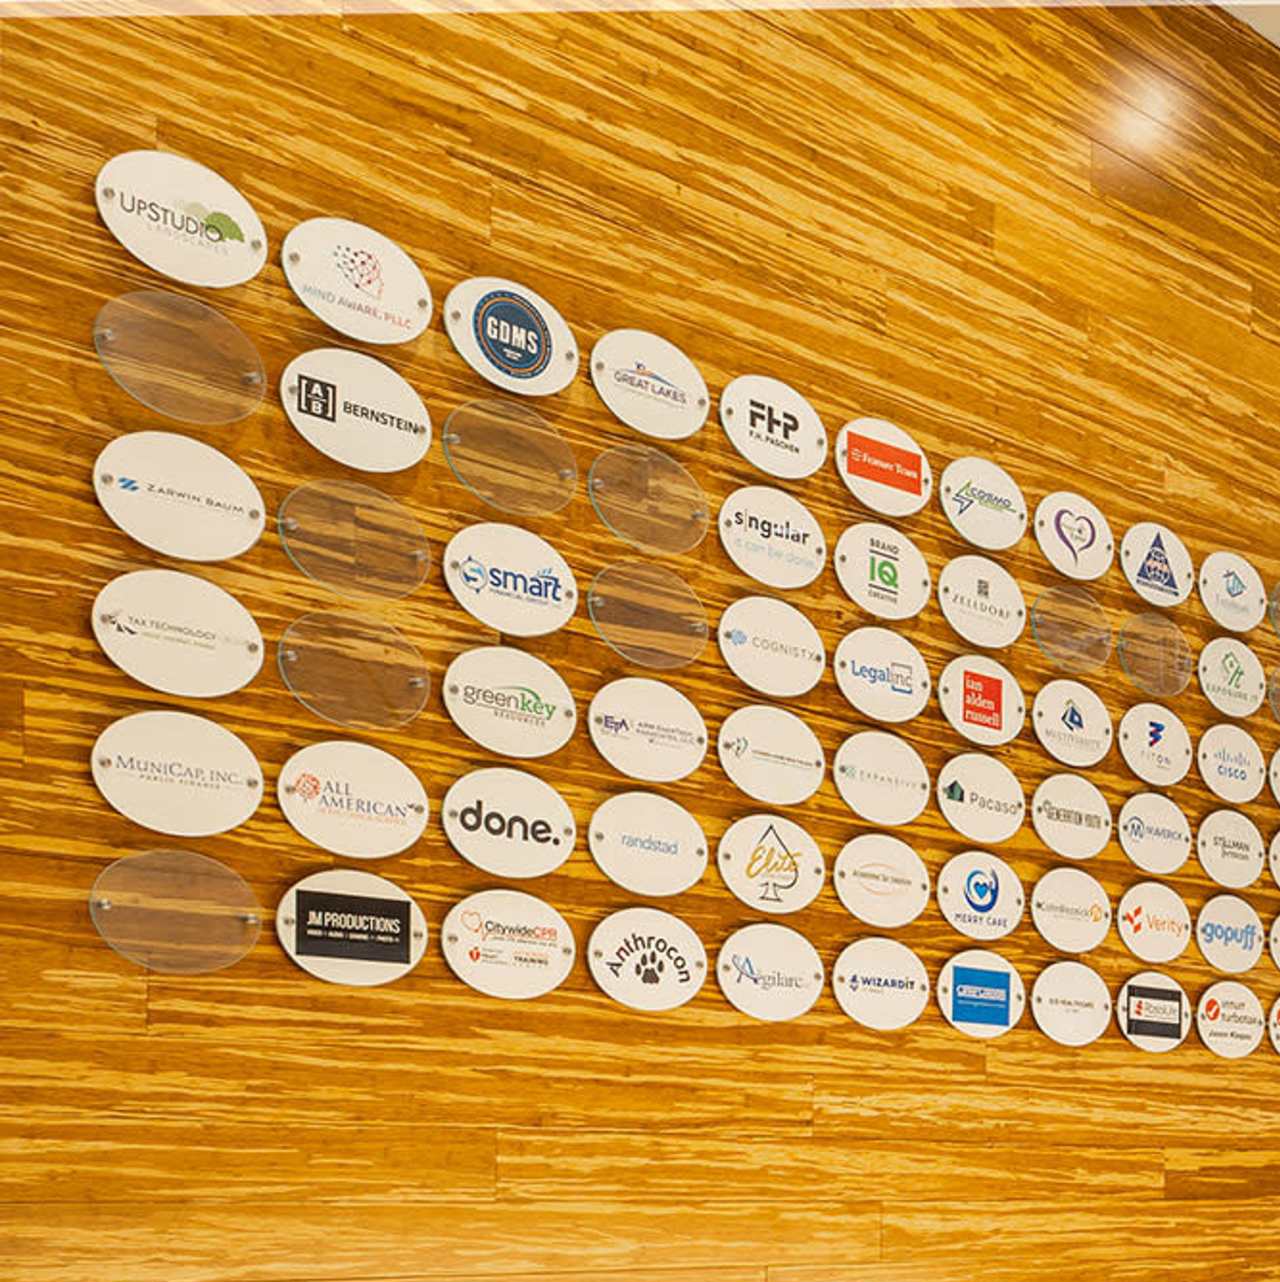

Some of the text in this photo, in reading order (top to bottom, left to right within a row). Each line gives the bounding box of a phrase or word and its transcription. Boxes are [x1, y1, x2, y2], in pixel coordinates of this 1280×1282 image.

[301, 285, 335, 304] MIND
[486, 316, 538, 354] GDMS
[614, 371, 651, 392] GREAT
[651, 382, 687, 404] LAKES
[342, 399, 419, 435] BERNSTEIN
[205, 494, 244, 514] BAUM
[870, 538, 899, 555] BRAND
[489, 567, 562, 602] smart
[868, 556, 899, 588] IQ
[127, 614, 147, 628] TAX
[149, 619, 217, 641] TECHNOLOGY
[463, 684, 557, 720] greenkey
[324, 779, 351, 797] ALL
[320, 792, 408, 819] AMERICAN
[969, 791, 1018, 816] Pacaso
[459, 800, 561, 846] done.
[621, 831, 678, 855] randstad
[306, 909, 402, 935] JM PRODUCTIONS
[1145, 914, 1183, 936] Verity
[1204, 922, 1257, 949] gopuff
[605, 933, 691, 984] Anthrocon
